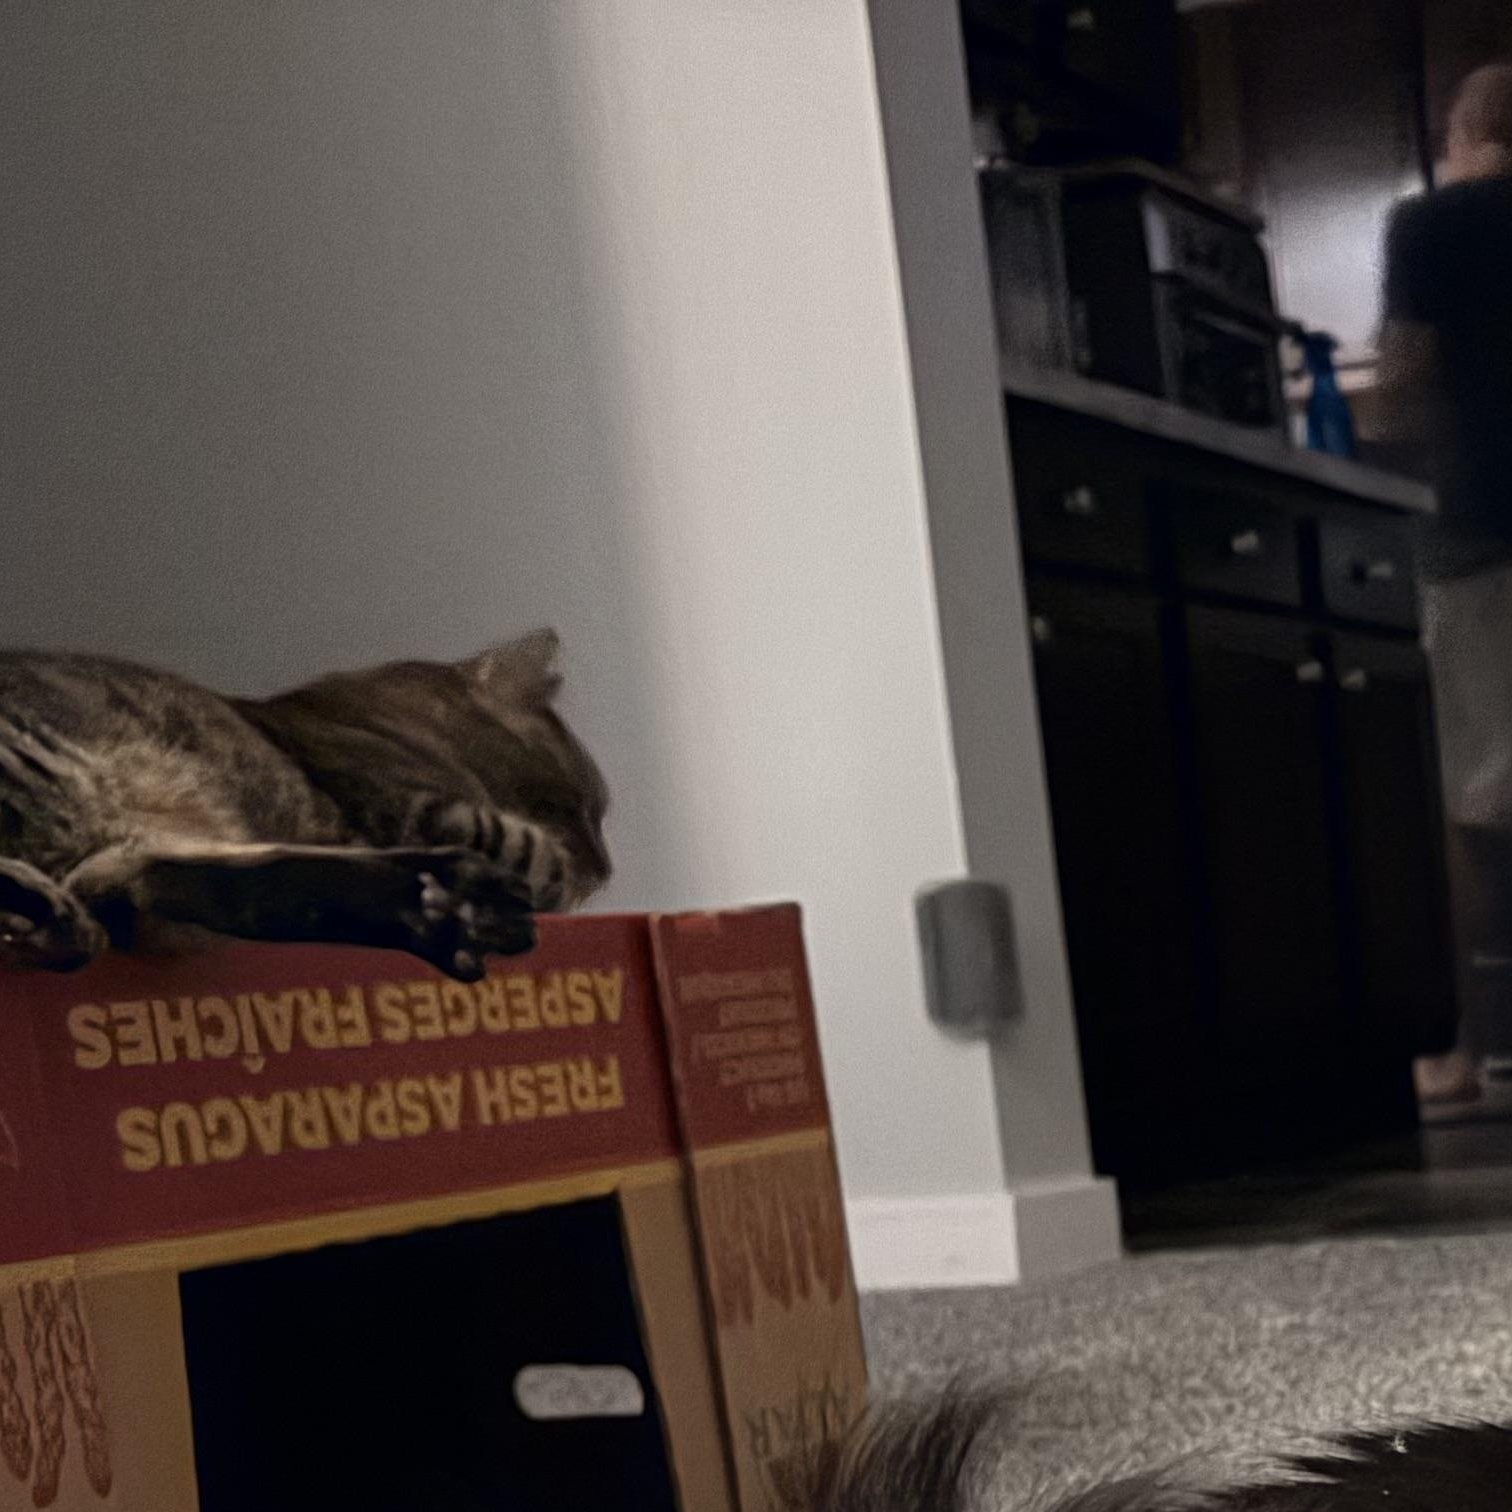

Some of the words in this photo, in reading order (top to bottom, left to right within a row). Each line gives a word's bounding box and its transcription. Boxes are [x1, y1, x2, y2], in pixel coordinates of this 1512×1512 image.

[66, 984, 372, 1075] FRAÎCHES
[375, 967, 624, 1045] ASPERGES
[115, 1071, 463, 1172] ASPARAGUS
[473, 1054, 625, 1126] FRESH
